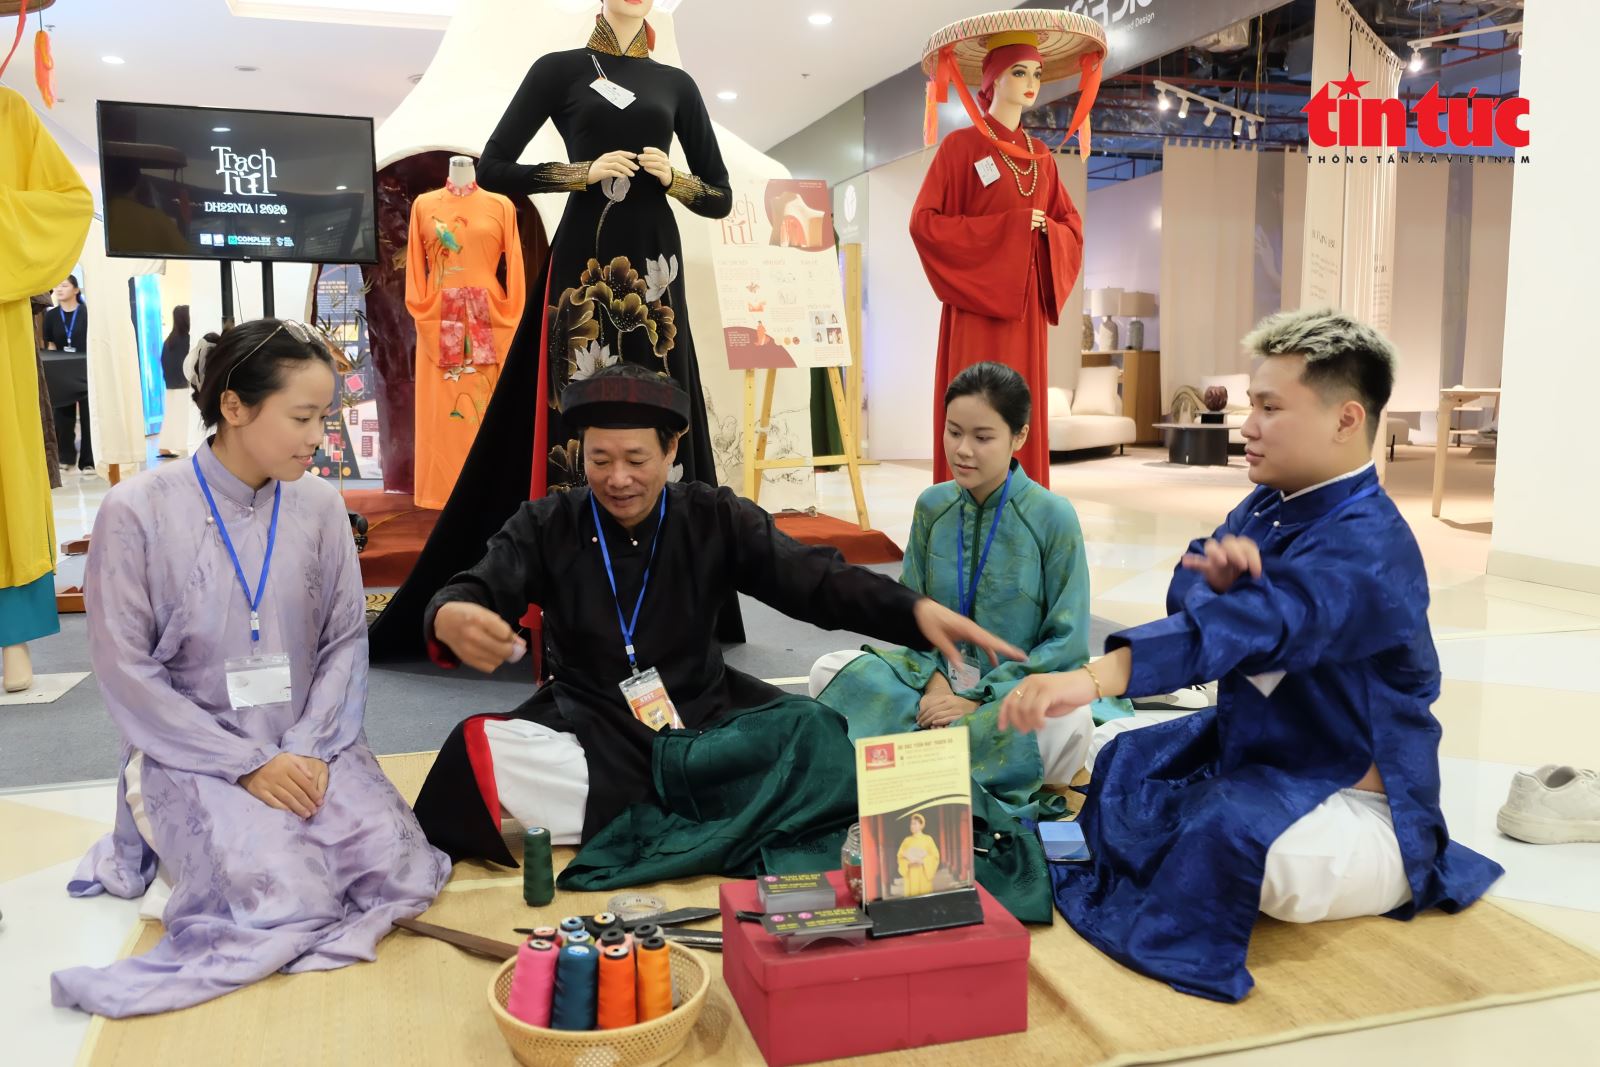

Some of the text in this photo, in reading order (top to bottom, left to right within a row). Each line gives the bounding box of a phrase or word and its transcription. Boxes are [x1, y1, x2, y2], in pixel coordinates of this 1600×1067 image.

[1135, 12, 1155, 28] Design
[204, 201, 254, 214] DH22NTA
[259, 204, 288, 215] 2026
